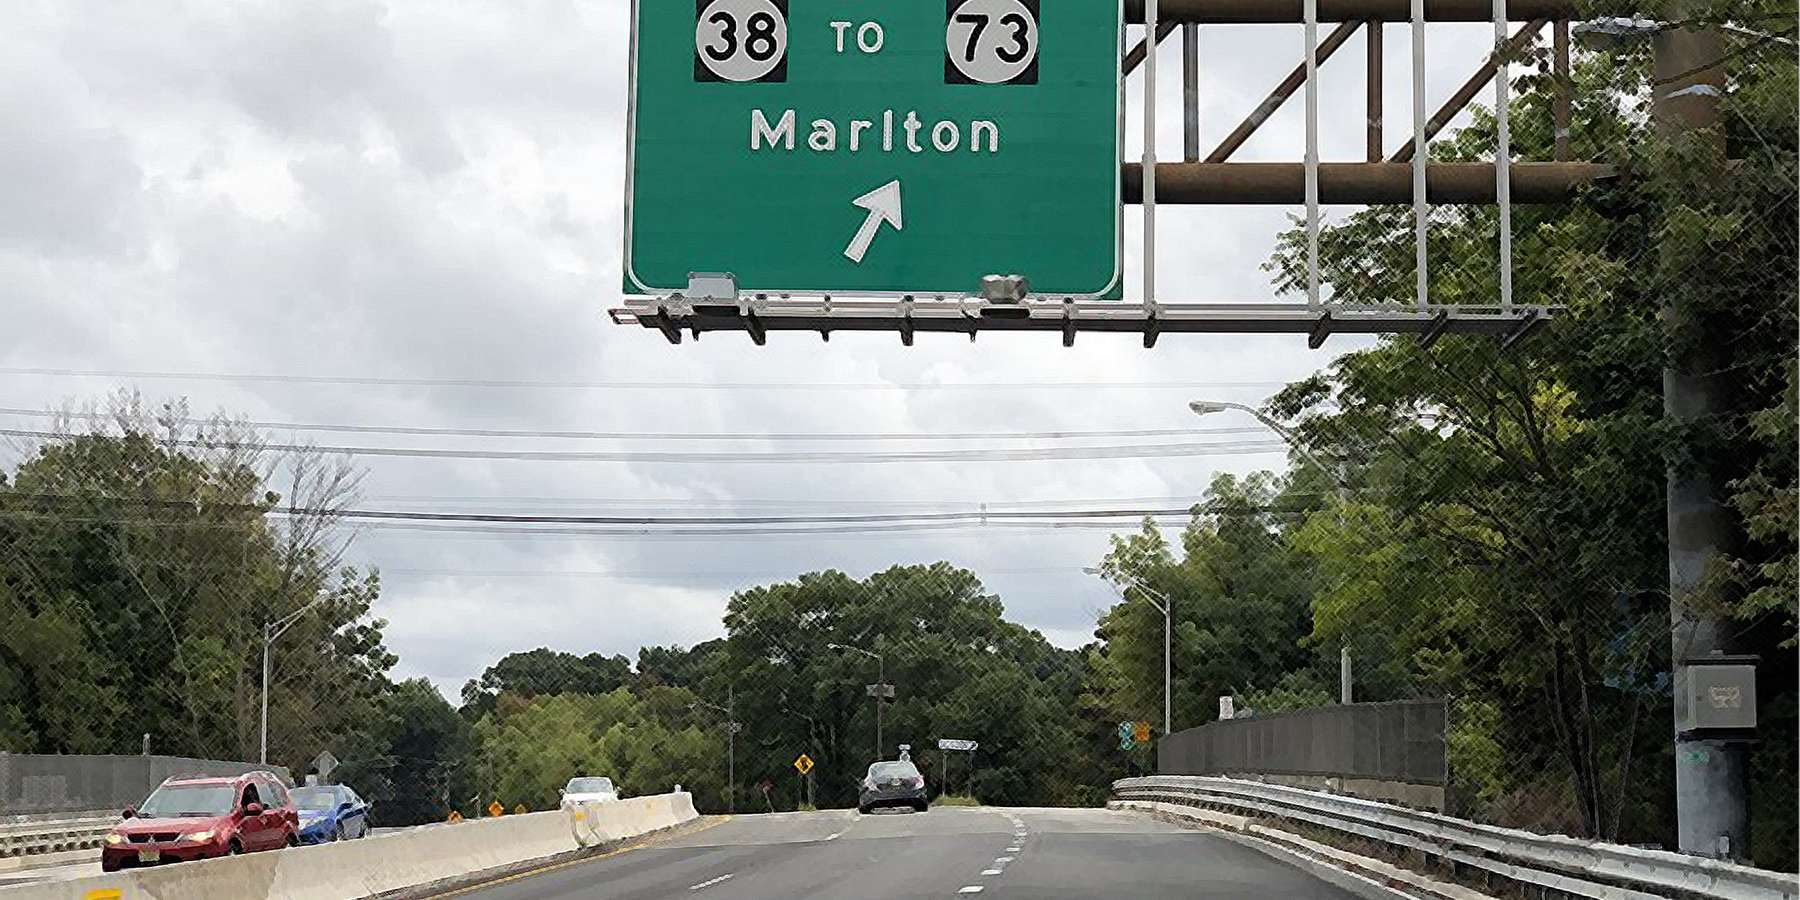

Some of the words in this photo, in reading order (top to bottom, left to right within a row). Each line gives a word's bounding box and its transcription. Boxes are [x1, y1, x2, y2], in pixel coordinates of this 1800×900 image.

[704, 11, 778, 62] 38
[829, 21, 884, 53] TO
[955, 13, 1029, 63] 73
[751, 109, 999, 152] Marlton
